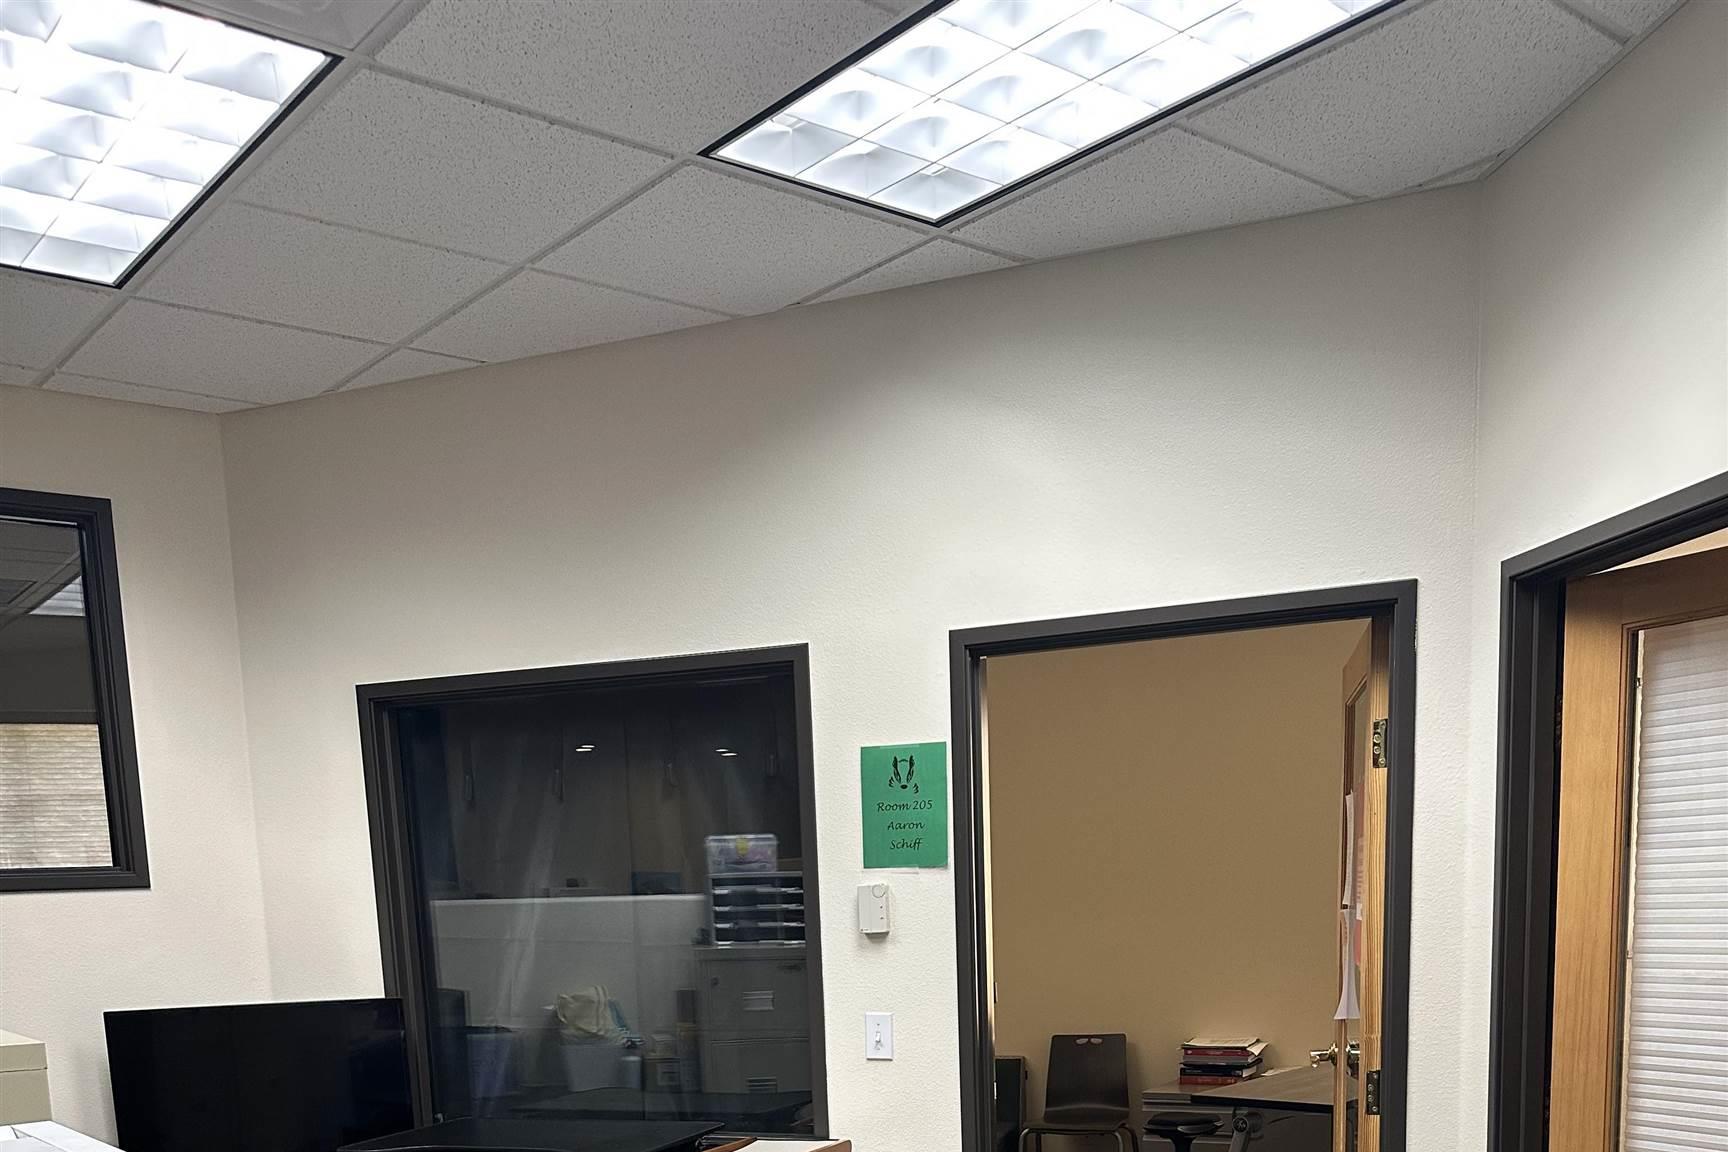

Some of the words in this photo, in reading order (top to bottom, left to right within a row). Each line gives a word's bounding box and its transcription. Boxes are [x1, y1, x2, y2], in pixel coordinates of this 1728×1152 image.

[877, 801, 911, 812] Room
[912, 799, 933, 811] 205
[887, 820, 926, 831] Aaron
[890, 838, 923, 851] Schiff
